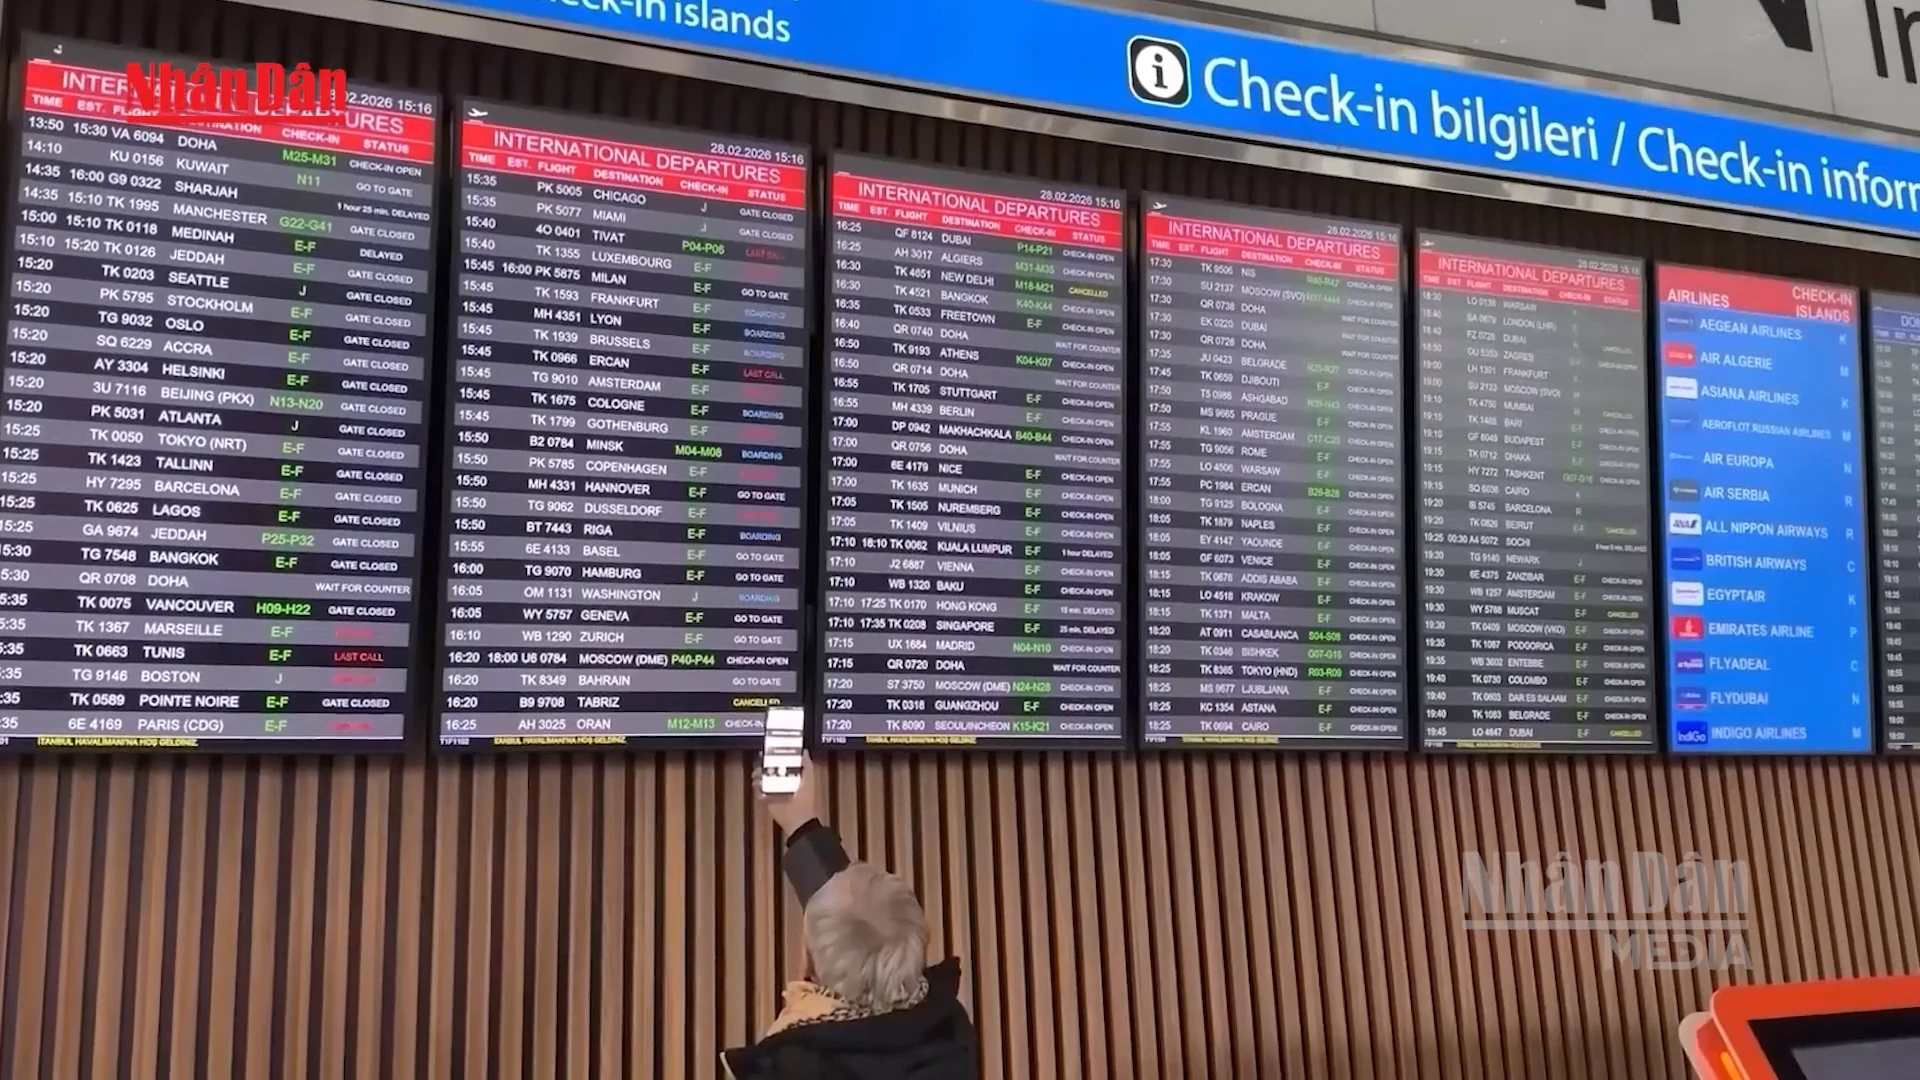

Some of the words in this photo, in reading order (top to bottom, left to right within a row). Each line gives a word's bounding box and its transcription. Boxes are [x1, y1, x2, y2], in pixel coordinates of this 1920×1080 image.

[674, 0, 791, 42] islands
[32, 95, 63, 108] TIME
[398, 100, 432, 114] 15:16
[1204, 56, 1417, 136] Check-in
[1432, 92, 1598, 161] bilgileri
[1609, 121, 1624, 167] /
[1639, 127, 1813, 194] Check-in
[29, 116, 64, 132] 13:50
[73, 121, 108, 137] 15:30
[112, 127, 129, 140] VA
[134, 130, 164, 144] 6094
[178, 136, 217, 151] DOHA
[283, 150, 337, 166] M25-M31
[283, 128, 340, 145] CHECK-IN
[364, 139, 409, 154] STATUS
[494, 130, 649, 168] INTERNATIONAL
[657, 152, 780, 184] DEPARTURES
[711, 143, 771, 160] 28.02.2026
[775, 152, 804, 165] 15:16
[28, 140, 62, 154] 14:10
[177, 159, 229, 175] KUWAIT
[297, 174, 320, 186] N11
[175, 180, 238, 199] SHARJAH
[467, 174, 496, 186] 15:35
[594, 190, 646, 204] CHICAGO
[594, 169, 663, 187] DESTINATION
[680, 180, 728, 195] CHECK-IN
[748, 189, 786, 202] STATUS
[859, 182, 989, 213] INTERNATIONAL
[995, 199, 1100, 227] DEPARTURES
[174, 203, 267, 225] MANCHESTER
[280, 216, 332, 233] G22-G41
[594, 210, 626, 222] MIAMI
[172, 226, 234, 243] MEDINAH
[593, 231, 625, 243] TIVAT
[836, 220, 861, 232] 16:25
[942, 233, 971, 245] DUBAI
[1169, 221, 1282, 248] INTERNATIONAL
[1287, 236, 1380, 259] DEPARTURES
[592, 252, 672, 269] LUXEMBOURG
[942, 253, 982, 265] ALGIERS
[1150, 258, 1172, 268] 17:30
[169, 271, 229, 288] SEATTLE
[464, 259, 494, 272] 15:45
[502, 262, 531, 275] 16:00
[592, 272, 626, 285] MILAN
[1439, 257, 1539, 281] INTERNATIONAL
[1543, 270, 1625, 291] DEPARTURES
[591, 293, 659, 309] FRANKFURT
[941, 290, 988, 304] BANGKOK
[1668, 289, 1730, 308] AIRLINES
[1792, 286, 1852, 305] CHECK-IN
[167, 295, 253, 314] STOCKHOLM
[590, 313, 621, 326] LYON
[941, 309, 995, 324] FREETOWN
[1796, 305, 1850, 322] ISLANDS
[1700, 318, 1749, 334] AEGEAN
[1751, 323, 1802, 340] AIRLINES
[1840, 334, 1847, 345] K
[590, 334, 650, 349] BRUSSELS
[940, 348, 979, 360] ATHENS
[1016, 356, 1052, 367] K04-K07
[1241, 357, 1286, 369] BELGRADE
[1701, 352, 1720, 364] AIR
[1724, 354, 1773, 370] ALGERIE
[162, 363, 225, 379] HELSINKI
[588, 376, 661, 391] AMSTERDAM
[161, 387, 214, 402] BEIJING
[219, 391, 254, 407] (PKX)
[270, 396, 323, 410] N13-N20
[940, 386, 997, 400] STUTTGART
[1701, 385, 1745, 399] ASIANA
[1749, 389, 1799, 405] AIRLINES
[7, 399, 42, 412] 15:20
[158, 410, 221, 426] ATLANTA
[940, 406, 974, 416] BERLIN
[1241, 411, 1277, 422] PRAGUE
[588, 418, 668, 434] GOTHENBURG
[939, 425, 1012, 440] MAKHACHKALA
[587, 439, 623, 452] MINSK
[1703, 452, 1723, 465] AIR
[1726, 454, 1774, 469] EUROPA
[155, 480, 240, 497] BARCELONA
[585, 482, 650, 495] HANNOVER
[1150, 477, 1171, 486] 17:55
[1241, 483, 1271, 493] ERCAN
[1705, 487, 1724, 499] AIR
[1728, 488, 1770, 501] SERBIA
[938, 503, 1000, 515] NUREMBERG
[1241, 501, 1283, 512] BOLOGNA
[1706, 523, 1728, 534] ALL
[1731, 524, 1773, 536] NIPPON
[1777, 525, 1828, 539] AIRWAYS
[262, 533, 314, 547] P25-P32
[81, 548, 100, 561] TG
[105, 549, 136, 562] 7548
[150, 551, 218, 566] BANGKOK
[1241, 556, 1273, 565] VENICE
[1706, 554, 1752, 567] BRITISH
[1755, 556, 1807, 571] AIRWAYS
[582, 568, 641, 579] HAMBURG
[582, 588, 661, 601] WASHINGTON
[1707, 589, 1765, 603] EGYPTAIR
[78, 596, 95, 608] TK
[100, 596, 131, 610] 0075
[147, 599, 234, 614] VANCOUVER
[257, 602, 310, 617] H09-H22
[937, 601, 966, 611] HONG
[968, 602, 996, 612] KONG
[581, 610, 629, 622] GENEVA
[936, 621, 994, 632] SINGAPORE
[1709, 623, 1767, 636] EMIRATES
[1771, 625, 1814, 638] AIRLINE
[1850, 628, 1857, 638] P
[1241, 629, 1298, 640] CASABLANCA
[143, 646, 185, 659] TUNIS
[936, 640, 975, 651] MADRID
[580, 654, 632, 665] MOSCOW
[635, 654, 668, 667] (DME)
[672, 654, 715, 665] P40-P44
[1710, 658, 1770, 671] FLYADEAL
[141, 671, 200, 683] BOSTON
[139, 694, 191, 708] POINTE
[195, 695, 239, 708] NOIRE
[578, 697, 620, 707] TABRIZ
[826, 699, 852, 710] 17:20
[935, 700, 998, 711] GUANGZHOU
[1711, 692, 1768, 705] FLYDUBAI
[1242, 702, 1276, 713] ASTANA
[577, 719, 611, 730] ORAN
[667, 718, 715, 730] M12-M13
[1712, 725, 1751, 739] INDIGO
[1755, 726, 1807, 739] AIRLINES
